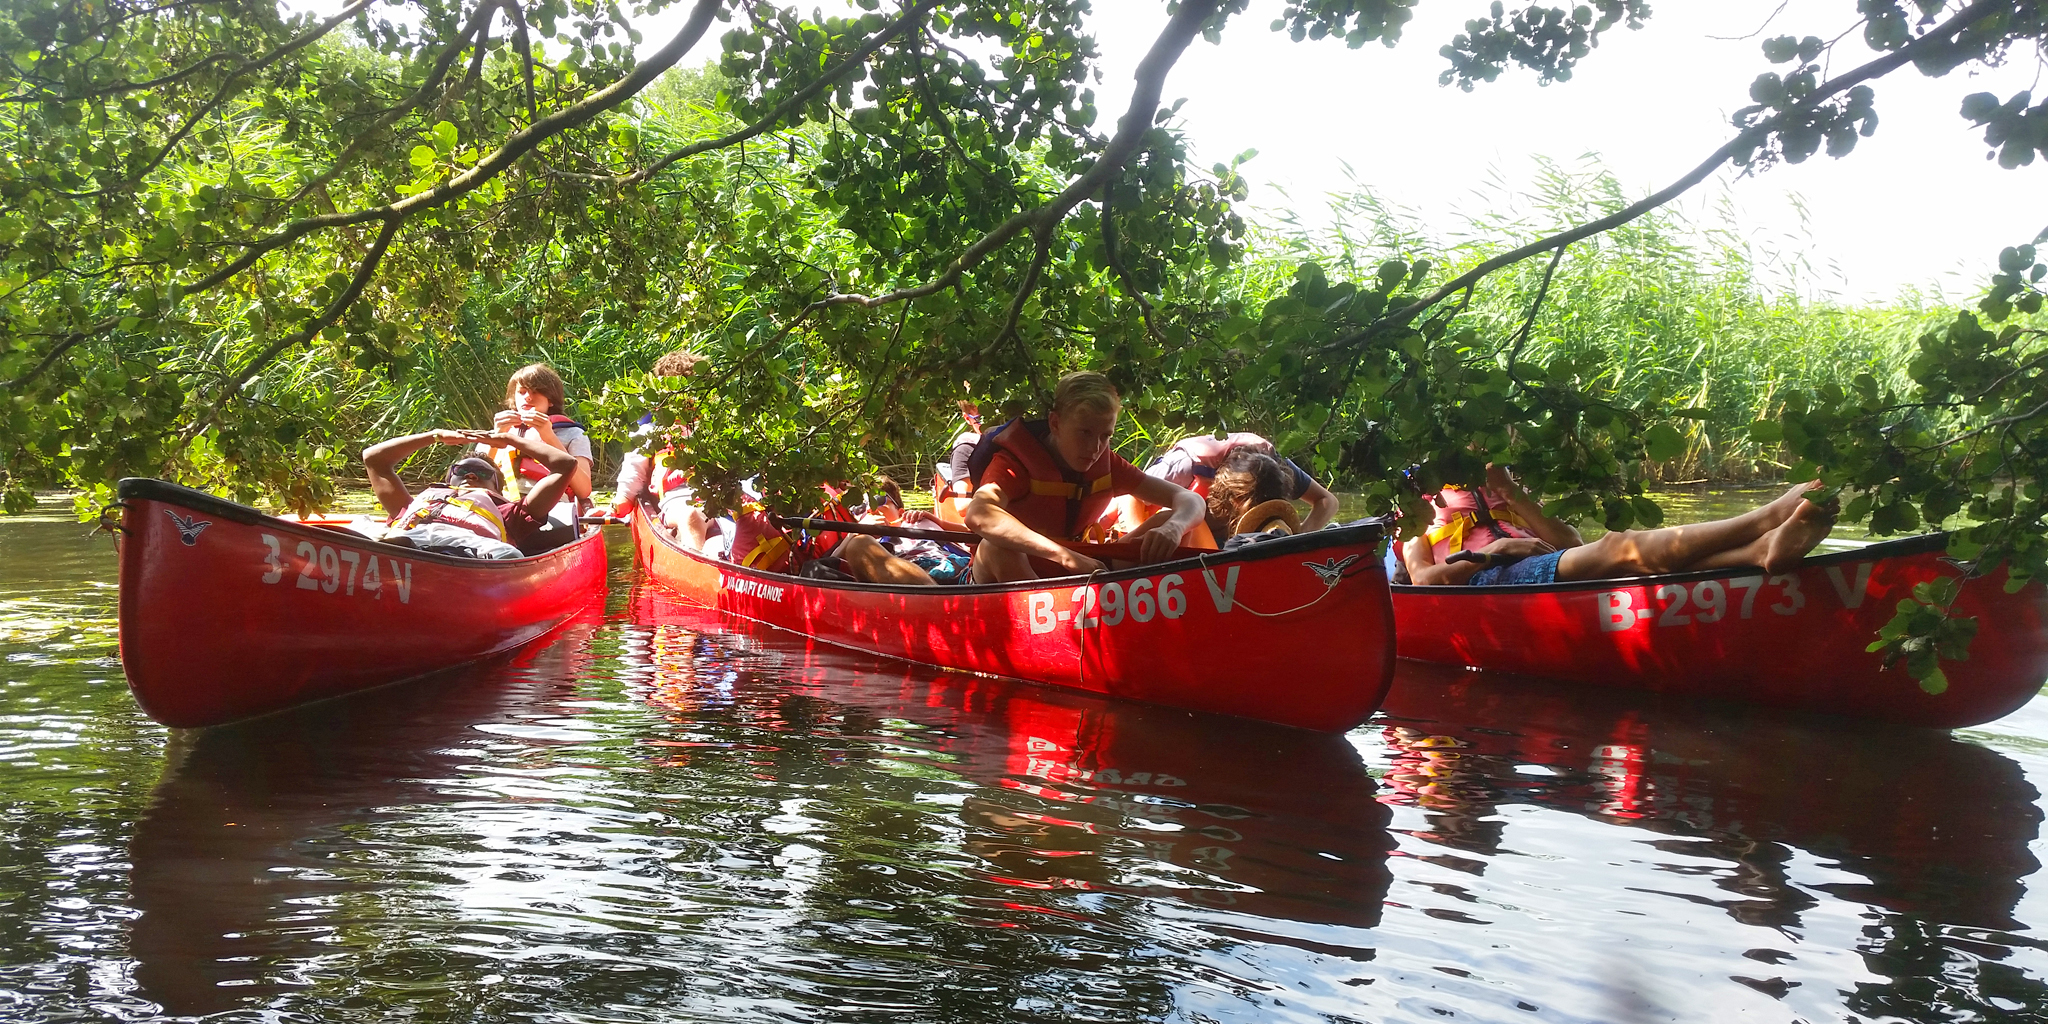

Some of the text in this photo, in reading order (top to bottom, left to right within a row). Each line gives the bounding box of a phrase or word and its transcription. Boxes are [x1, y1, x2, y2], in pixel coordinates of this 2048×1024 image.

[390, 559, 412, 604] V
[757, 583, 784, 603] CANOE
[1028, 566, 1241, 635] B-2966 V
[1598, 562, 1874, 632] B-2973 V
